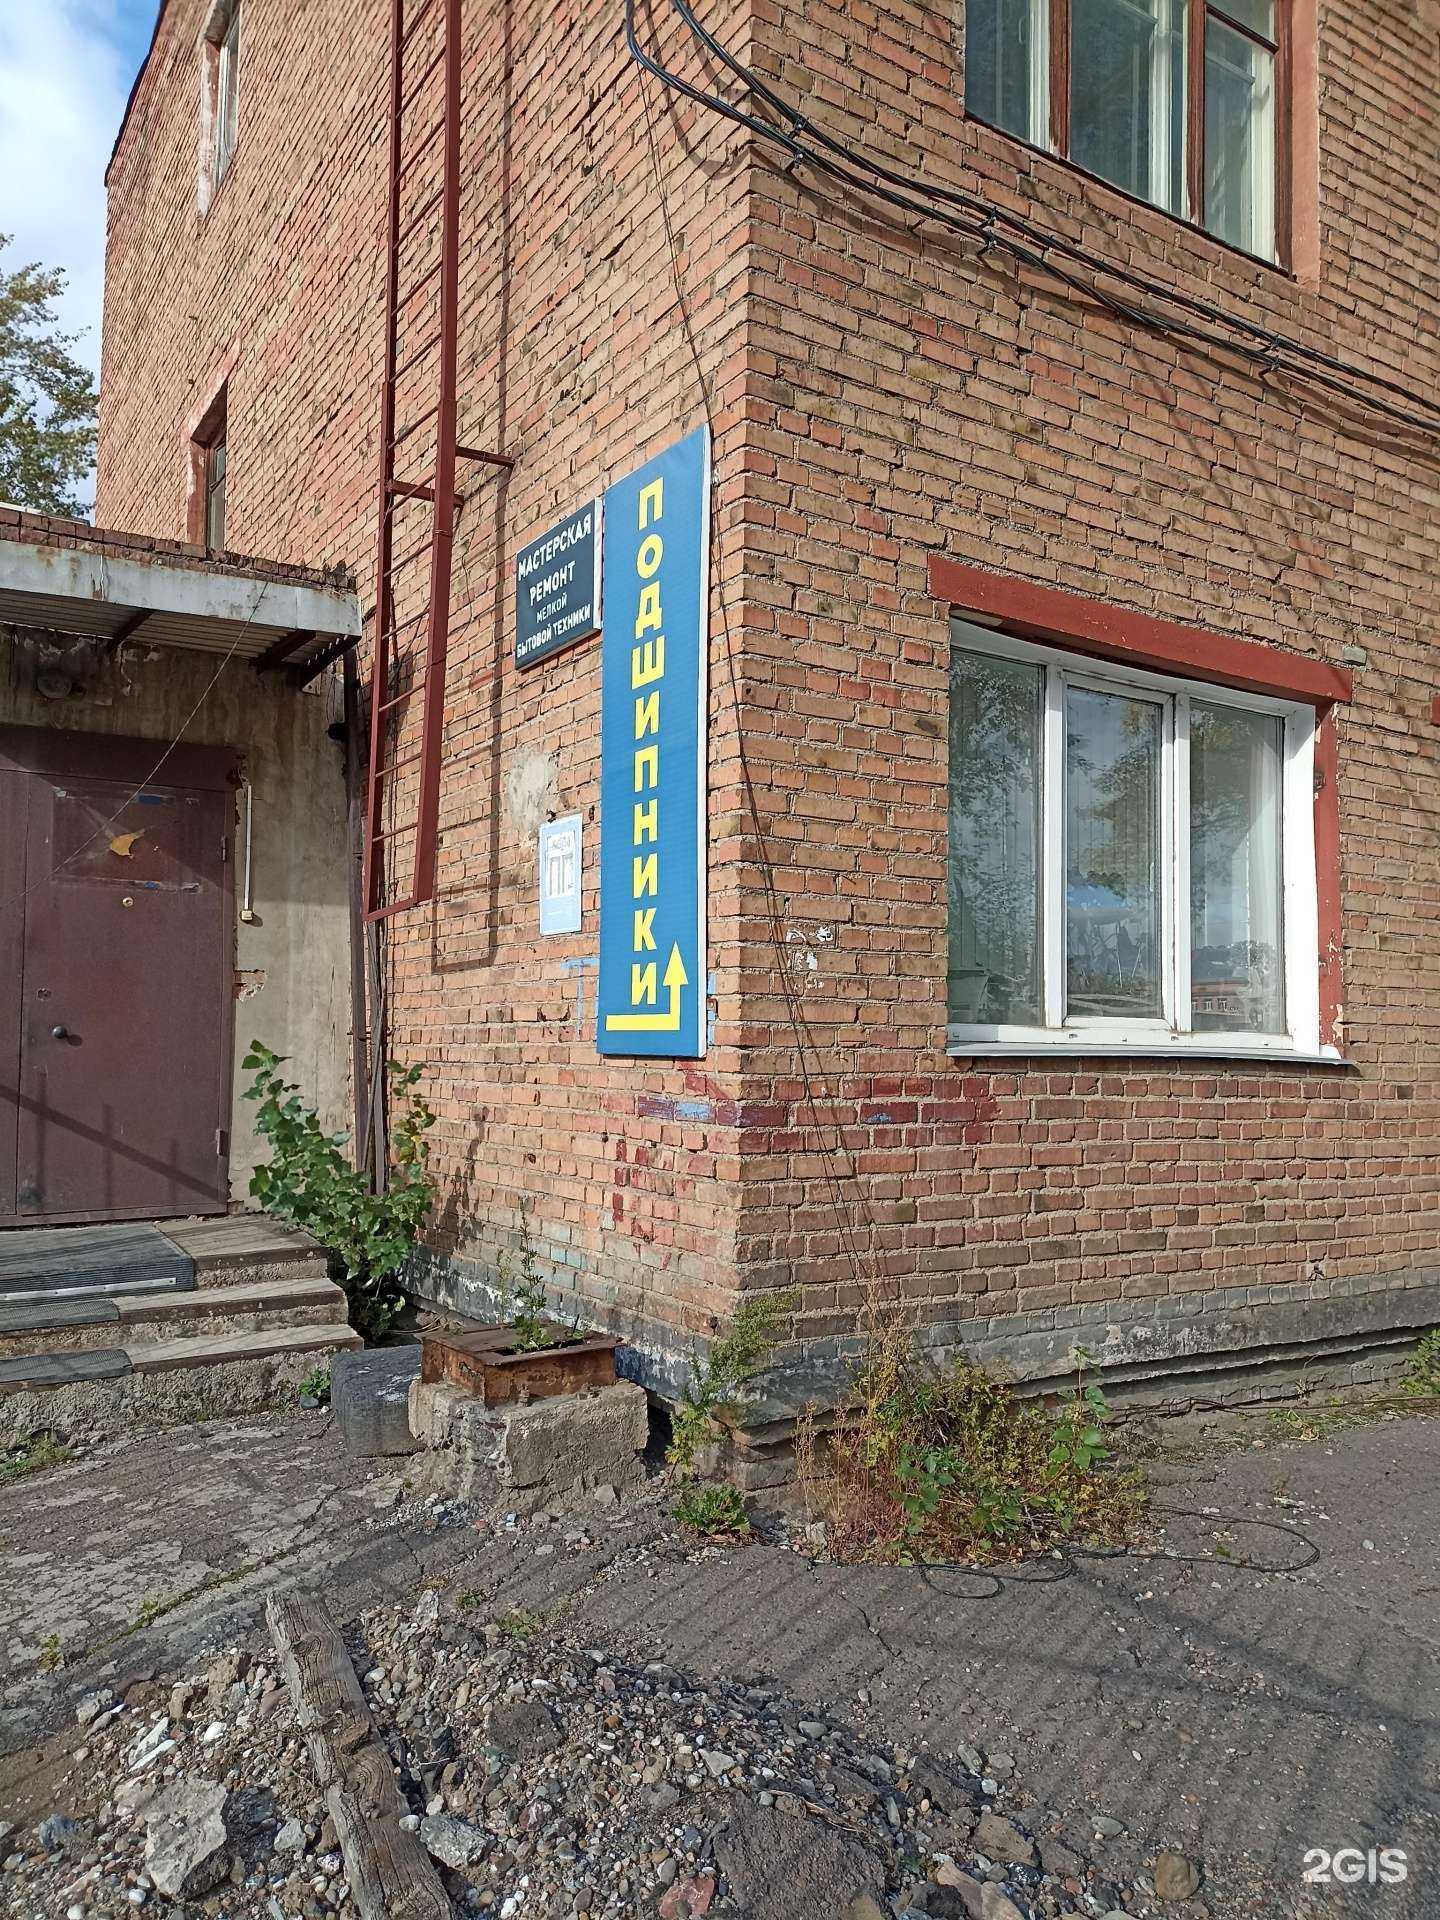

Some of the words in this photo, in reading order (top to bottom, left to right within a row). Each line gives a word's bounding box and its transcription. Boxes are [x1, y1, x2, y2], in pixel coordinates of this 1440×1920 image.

[517, 512, 592, 582] МАСТЕРСКАЯ
[529, 560, 576, 607] РЕМОНТ
[536, 591, 568, 624] МЕЛКОЙ
[516, 622, 552, 658] БЫТОВОЙ
[552, 602, 592, 637] ТЕХНИКИ
[631, 476, 665, 1006] ПОДШИПНИКИ
